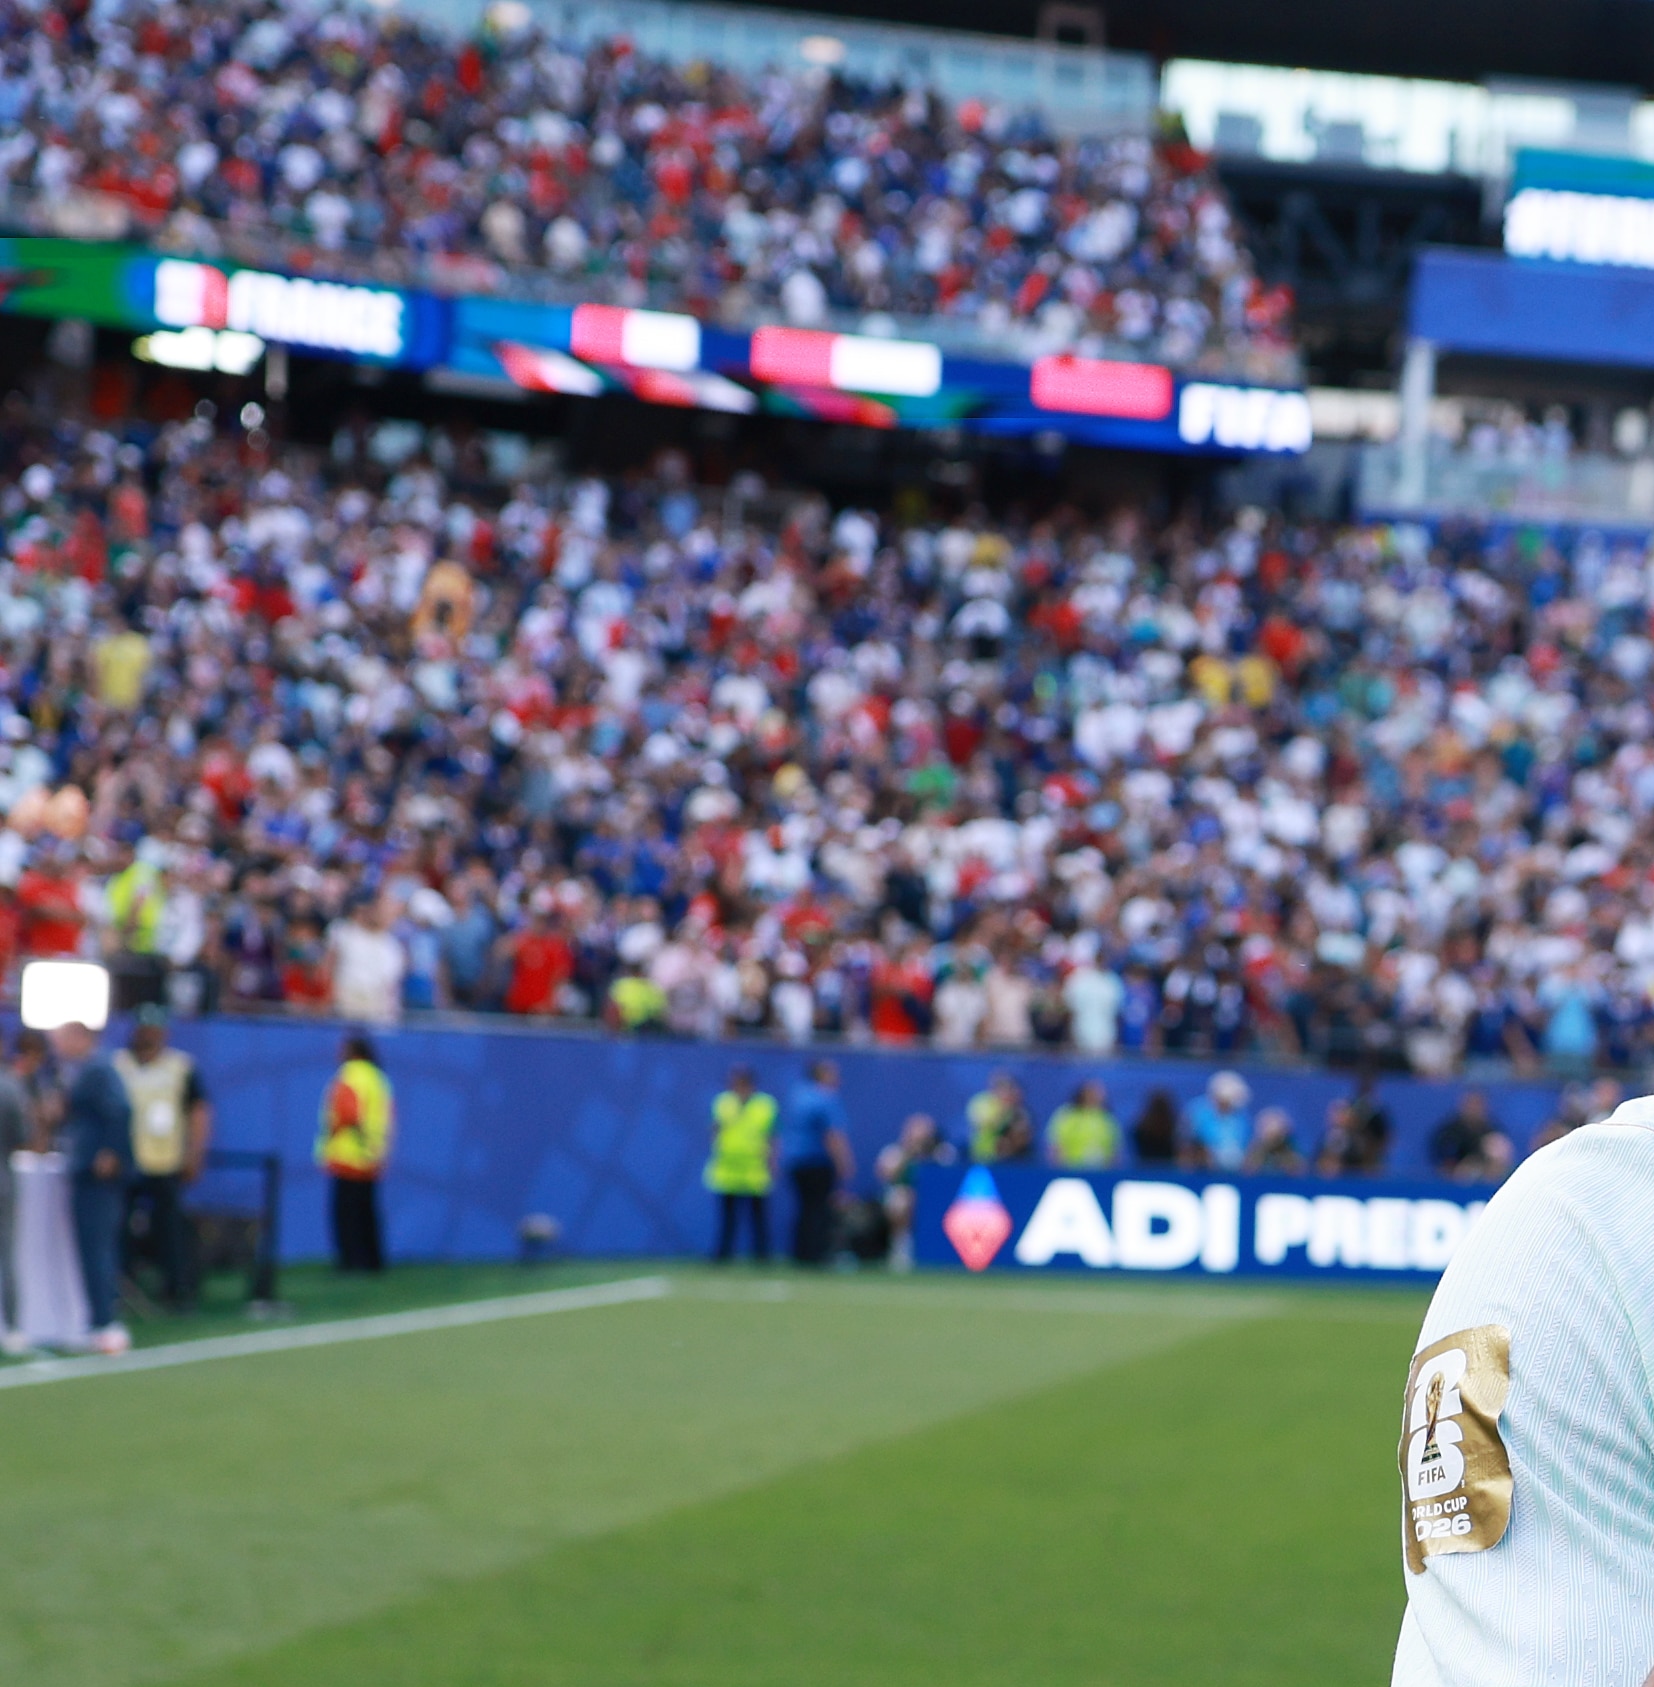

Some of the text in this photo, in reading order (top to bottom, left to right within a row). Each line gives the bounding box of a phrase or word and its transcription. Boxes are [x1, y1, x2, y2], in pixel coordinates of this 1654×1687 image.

[1014, 1177, 1487, 1273] ADI PRED
[1418, 1466, 1446, 1486] FIFA
[1444, 1496, 1467, 1513] CUP
